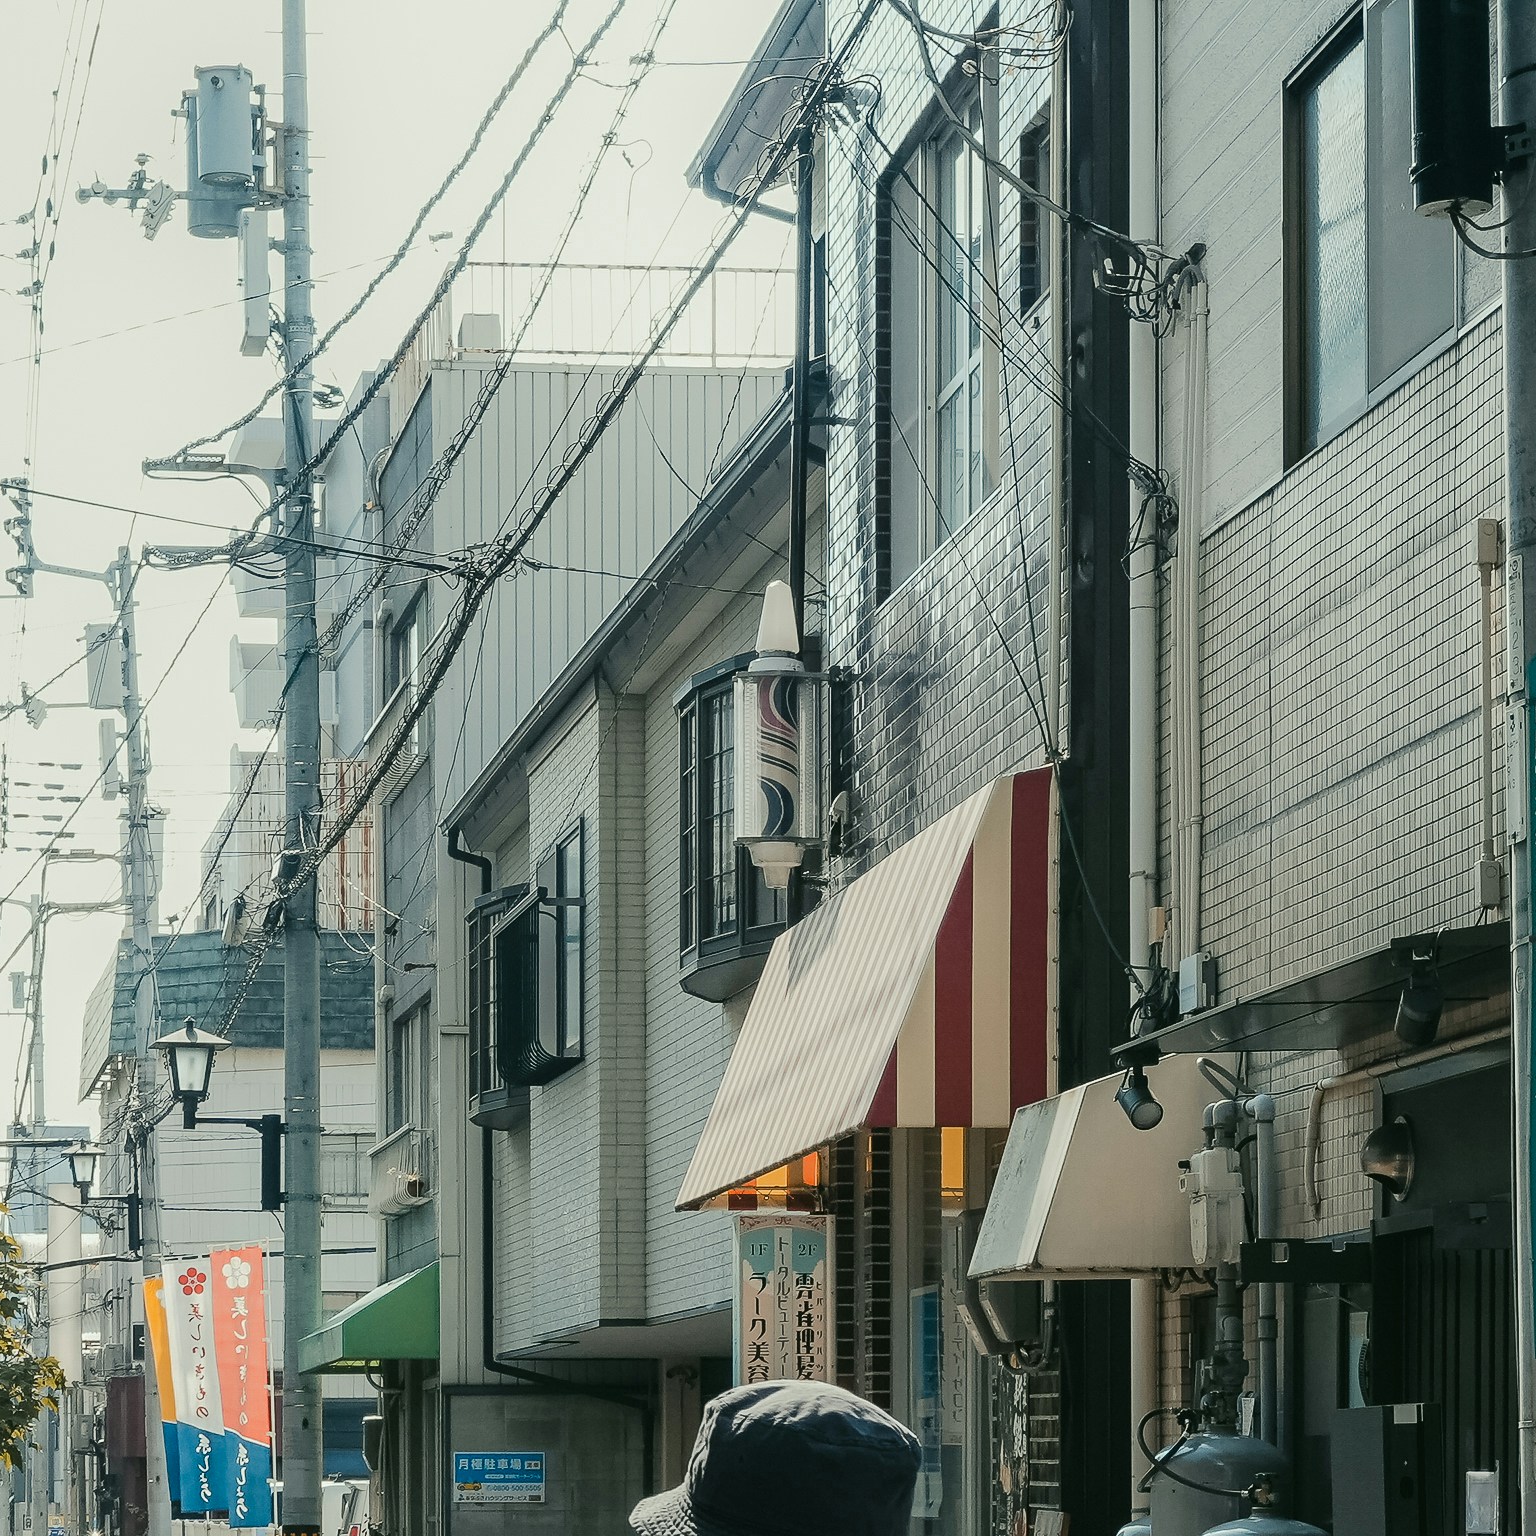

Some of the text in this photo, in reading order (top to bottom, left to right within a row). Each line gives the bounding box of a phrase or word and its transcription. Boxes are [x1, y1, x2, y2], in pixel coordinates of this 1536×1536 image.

[750, 1243, 769, 1256] 1F
[798, 1243, 818, 1256] 2F
[458, 1458, 522, 1470] 月極駐車場
